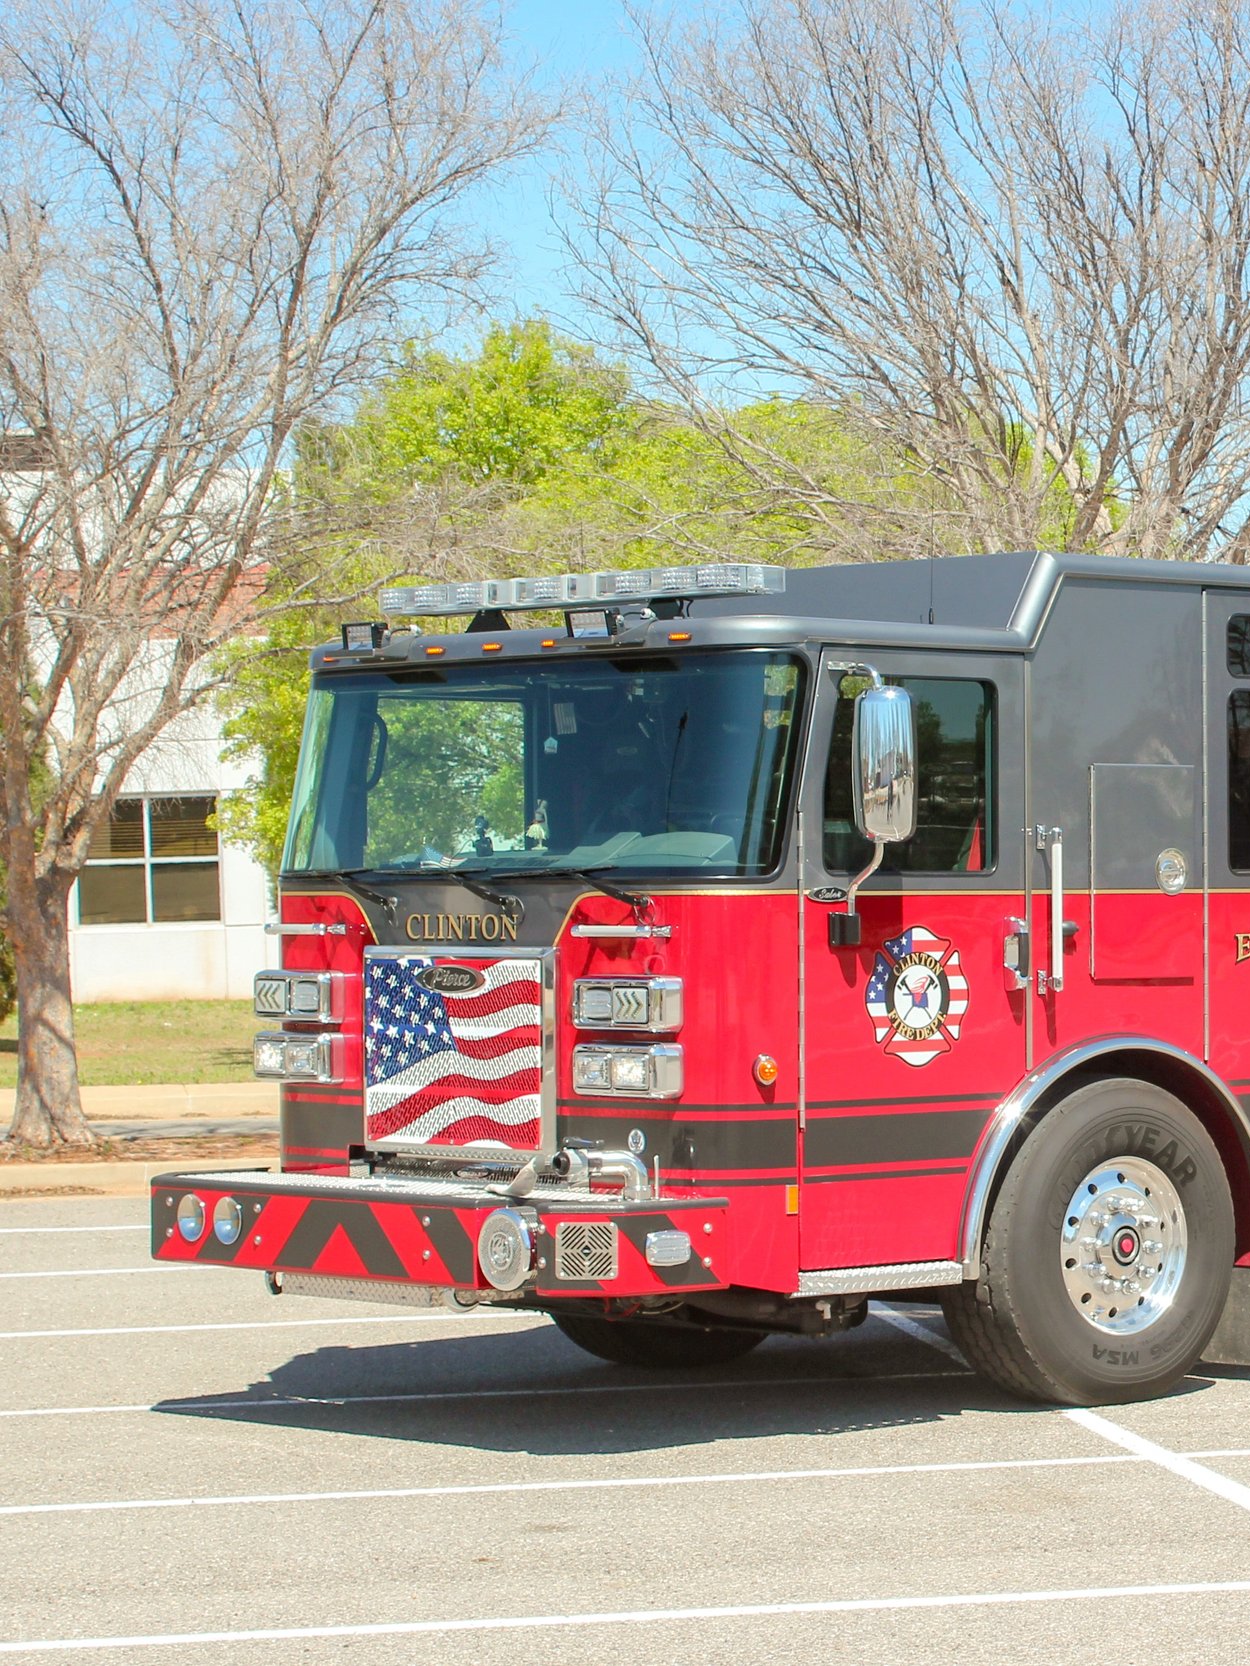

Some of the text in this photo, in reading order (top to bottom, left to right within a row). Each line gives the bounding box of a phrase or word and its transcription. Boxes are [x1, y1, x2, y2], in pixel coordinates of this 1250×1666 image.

[406, 913, 519, 941] CLINTON
[893, 952, 943, 976] CLINTON
[430, 968, 472, 988] Pierce
[888, 1009, 914, 1040] FIRE
